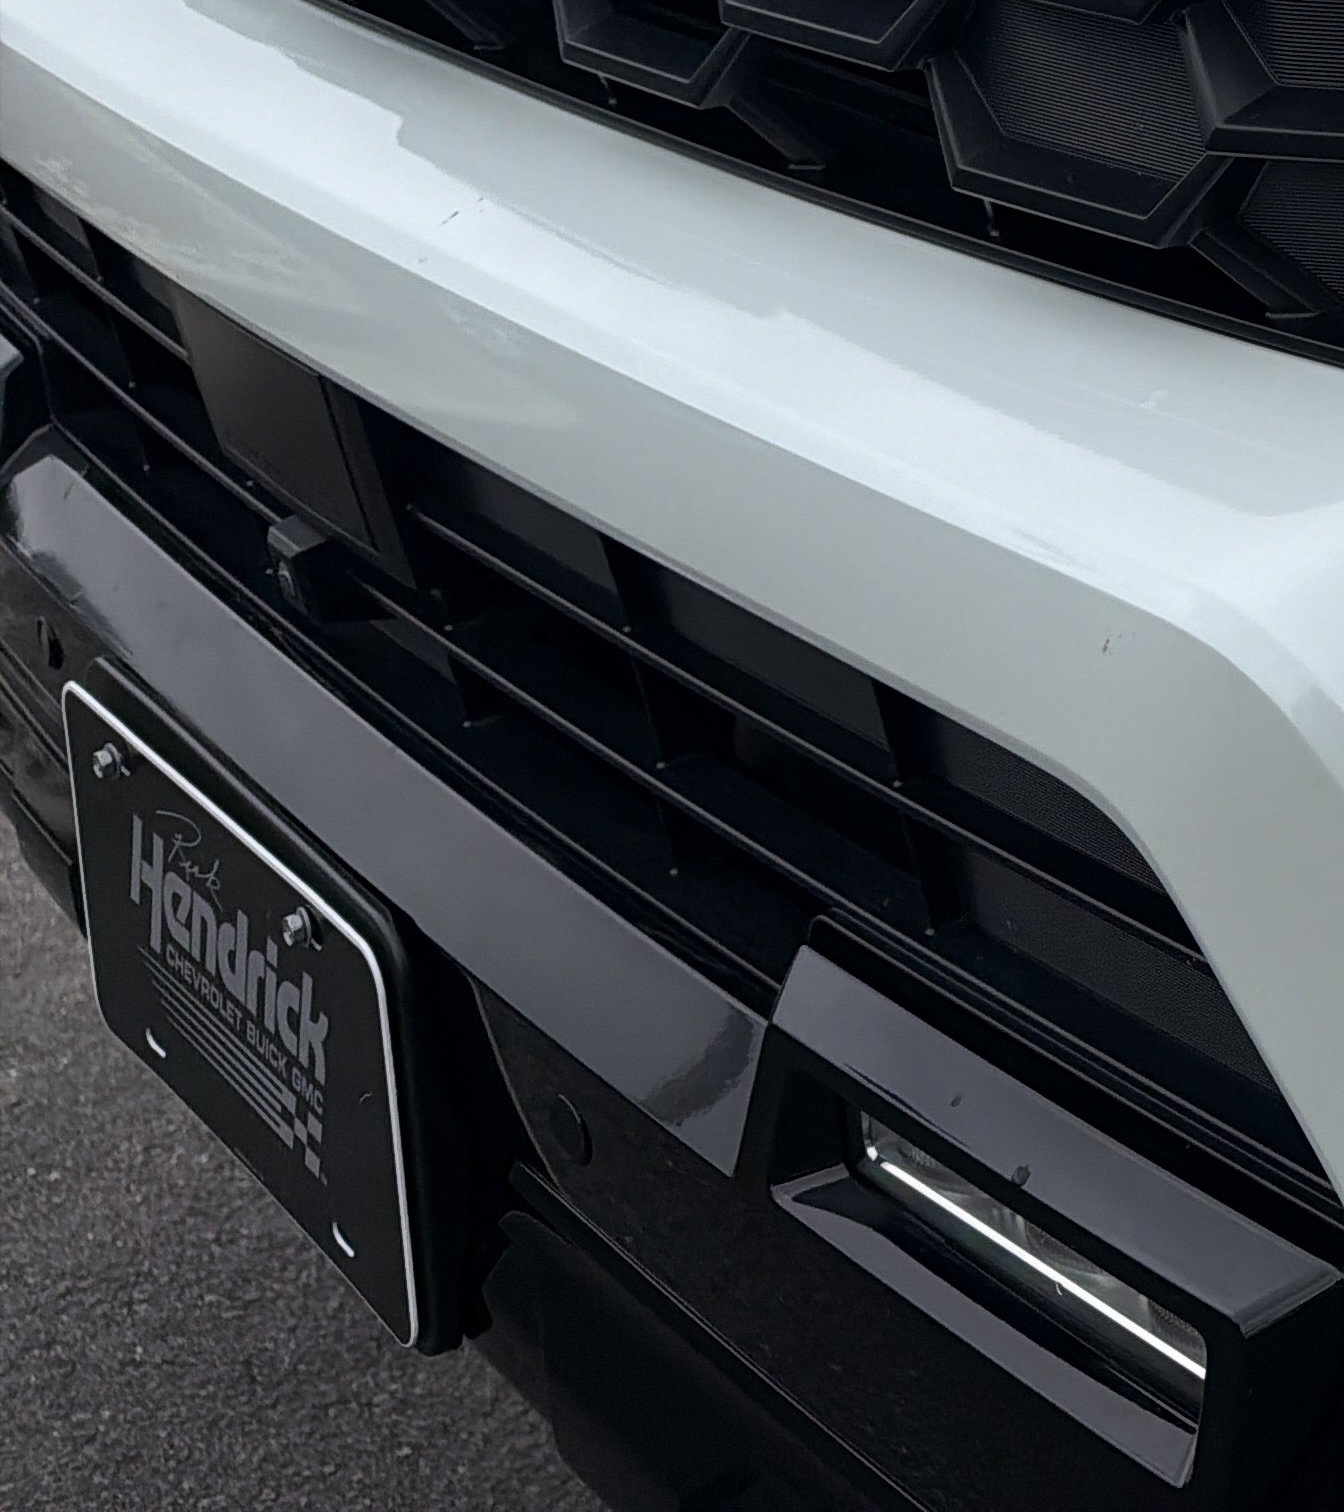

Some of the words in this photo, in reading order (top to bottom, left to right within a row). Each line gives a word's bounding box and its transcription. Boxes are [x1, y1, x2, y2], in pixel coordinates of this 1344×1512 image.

[130, 813, 329, 1087] Hendrick
[166, 944, 242, 1032] CHEVROLET
[246, 1020, 287, 1080] BUICK
[292, 1065, 323, 1115] GMC
